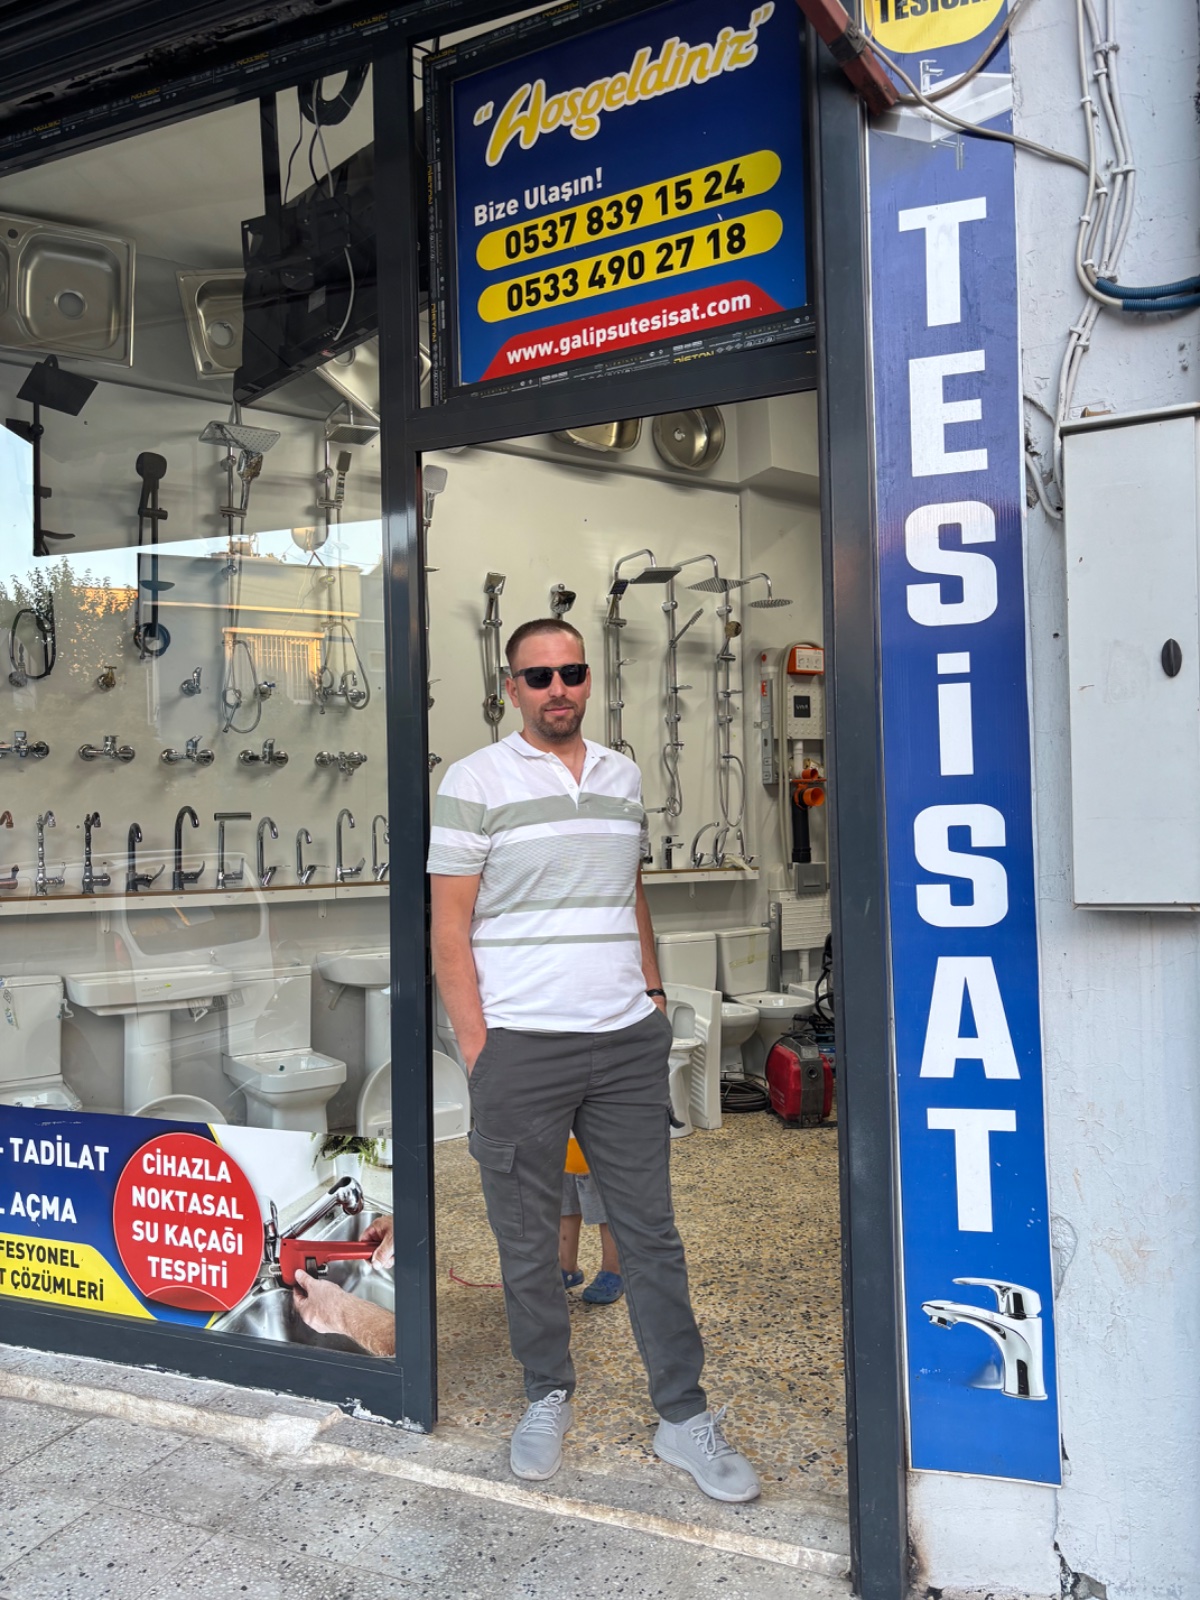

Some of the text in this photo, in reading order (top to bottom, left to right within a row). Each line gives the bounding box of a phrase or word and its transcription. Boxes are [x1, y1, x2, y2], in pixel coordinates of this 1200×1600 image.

[474, 167, 602, 227] Bize Ulaşın!
[505, 163, 745, 259] 0537 839 15 24
[507, 223, 746, 312] 0533 490 27 18
[506, 293, 751, 365] www.galipsutesisat.com
[9, 1135, 109, 1171] TADİLAT
[142, 1148, 232, 1183] CİHAZLA
[10, 1191, 77, 1224] AÇMA
[131, 1185, 244, 1220] NOKTASAL
[132, 1220, 243, 1255] SU KAÇAĞI
[11, 1267, 104, 1301] ÇÖZÜMLERİ
[147, 1256, 228, 1288] TESPİTİ
